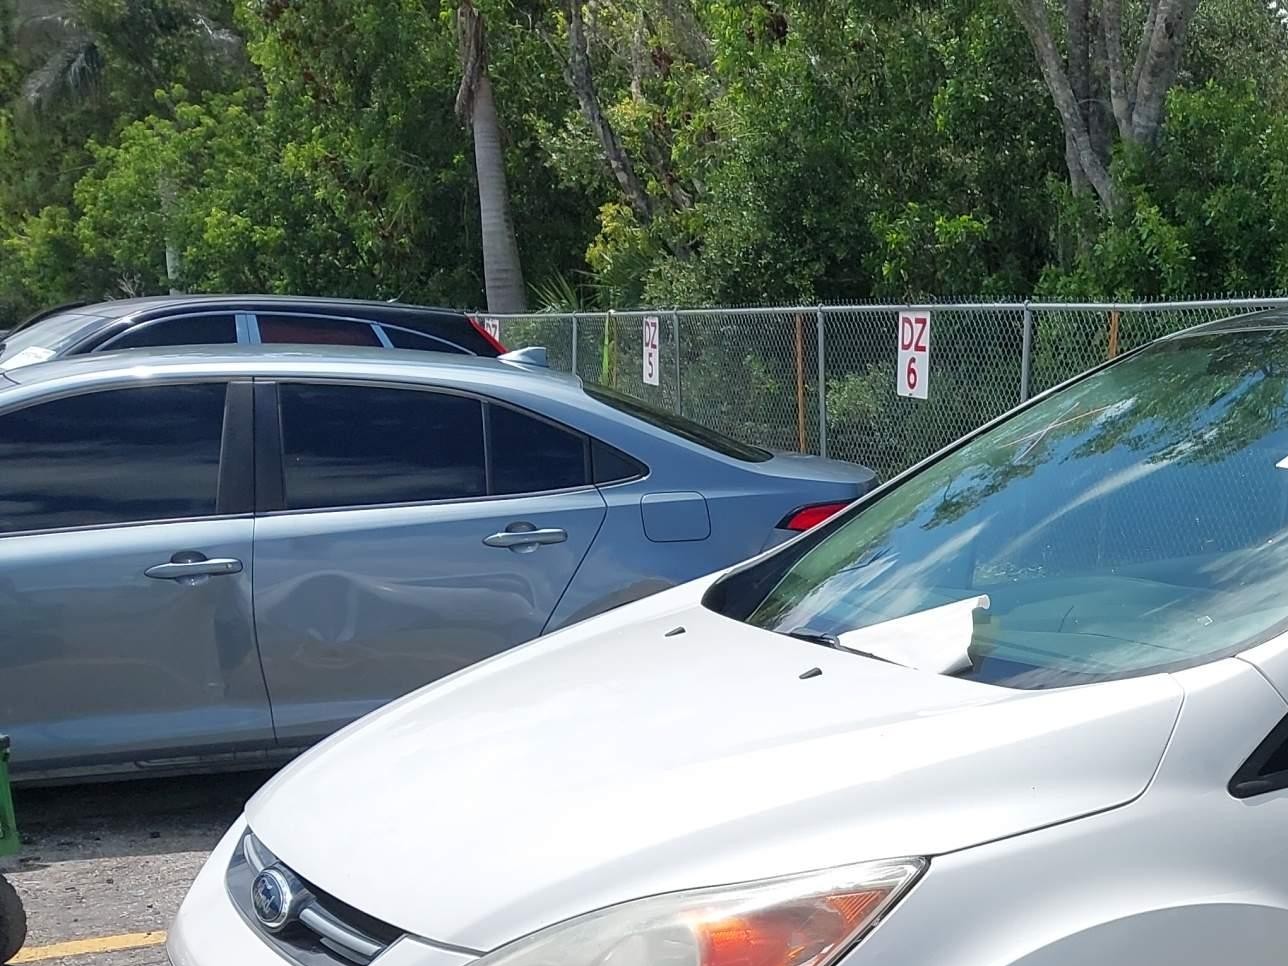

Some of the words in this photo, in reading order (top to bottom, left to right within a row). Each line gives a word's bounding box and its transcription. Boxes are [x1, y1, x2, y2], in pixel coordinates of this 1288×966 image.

[645, 320, 657, 349] DZ
[901, 316, 927, 352] DZ
[648, 352, 653, 378] 5
[907, 356, 917, 390] 6
